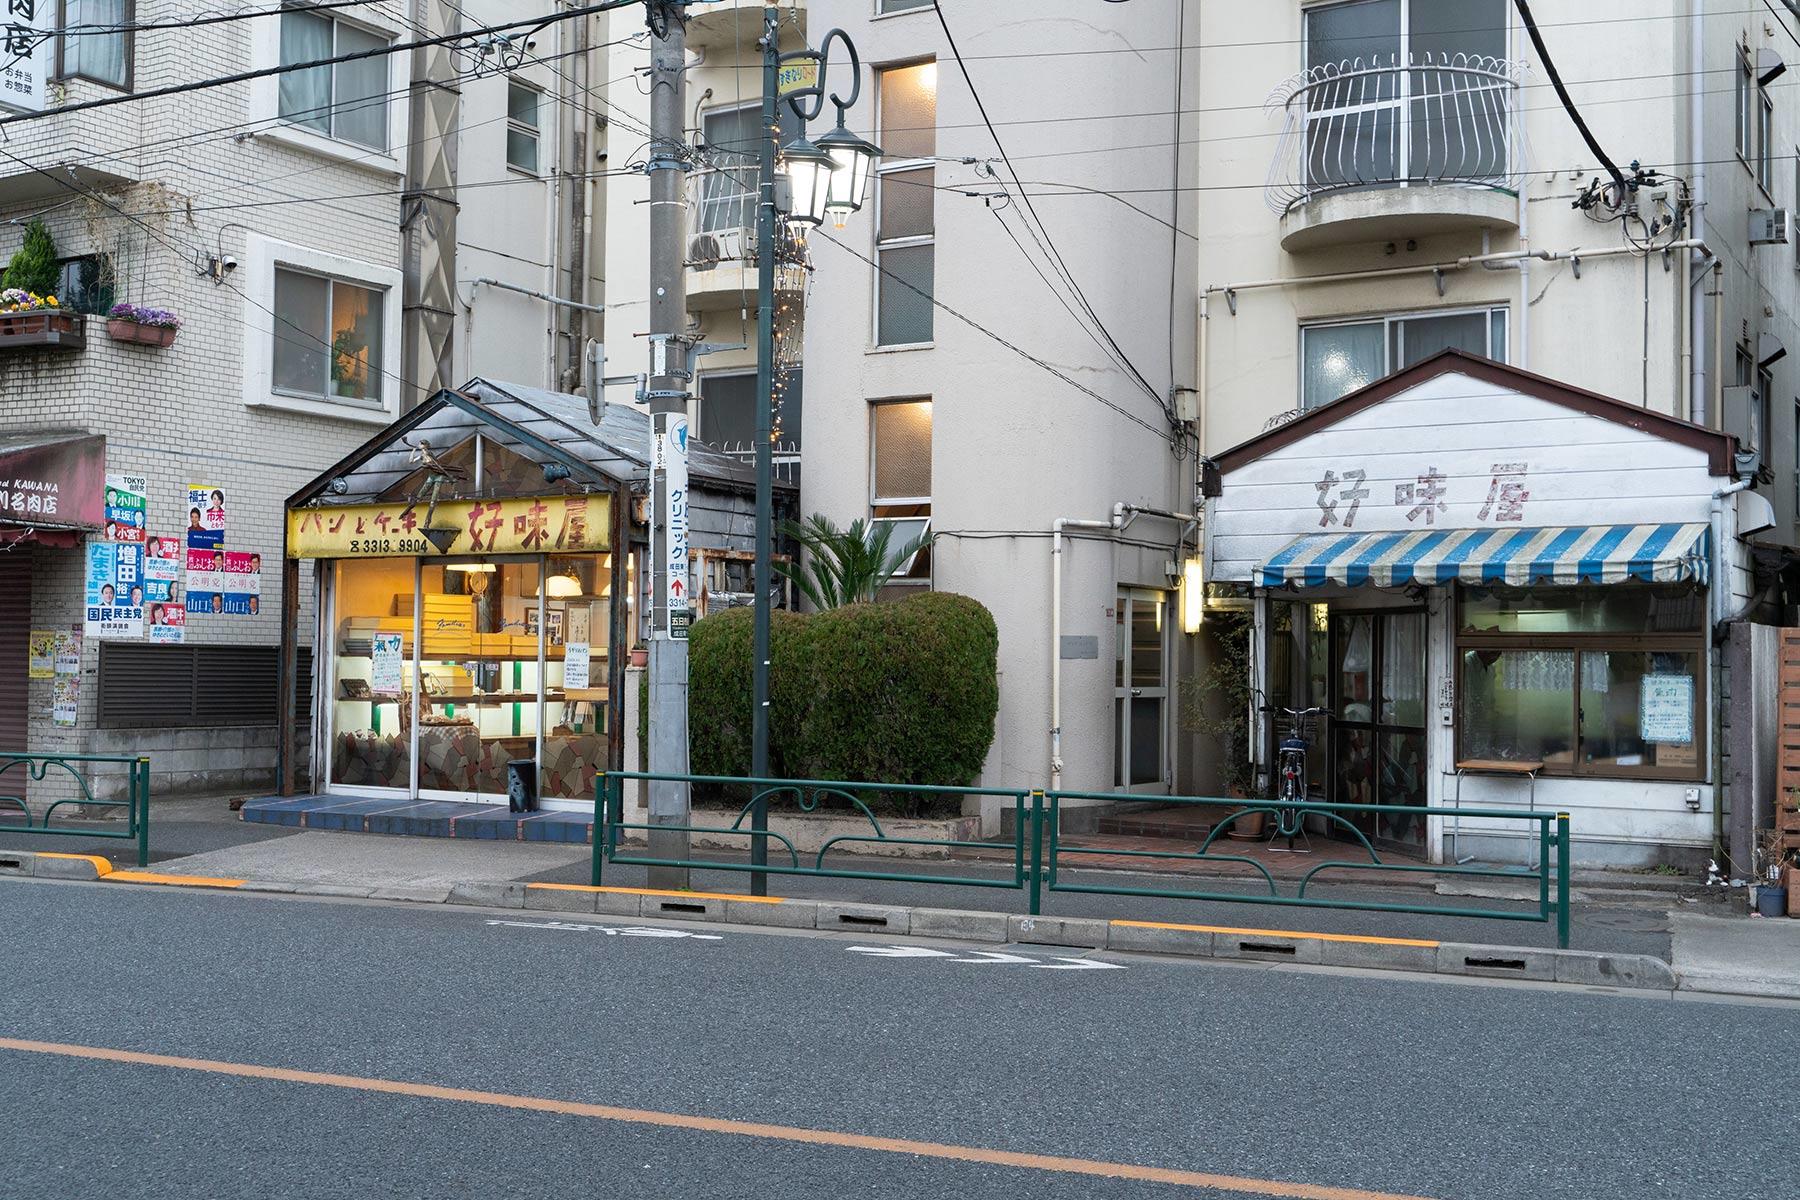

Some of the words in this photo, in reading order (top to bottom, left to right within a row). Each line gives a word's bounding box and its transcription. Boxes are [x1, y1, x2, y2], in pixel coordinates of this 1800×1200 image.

[5, 68, 33, 83] お弁当
[4, 79, 33, 96] お惣菜
[13, 478, 59, 494] KAWANA
[122, 476, 146, 485] TOKYO
[117, 495, 137, 508] 小川
[188, 489, 208, 504] 福士
[1315, 462, 1530, 528] 好味屋
[111, 509, 132, 522] 早坂
[467, 498, 591, 552] 好味屋
[669, 489, 682, 560] クリニック
[117, 528, 137, 540] 小宮
[91, 544, 110, 582] たまき
[117, 545, 137, 583] 増田
[147, 582, 168, 594] 吉良
[190, 576, 221, 587] 公明党
[228, 578, 257, 590] 公明党
[187, 599, 208, 612] 山口
[225, 601, 245, 613] 山口
[88, 608, 143, 622] 国民民主党
